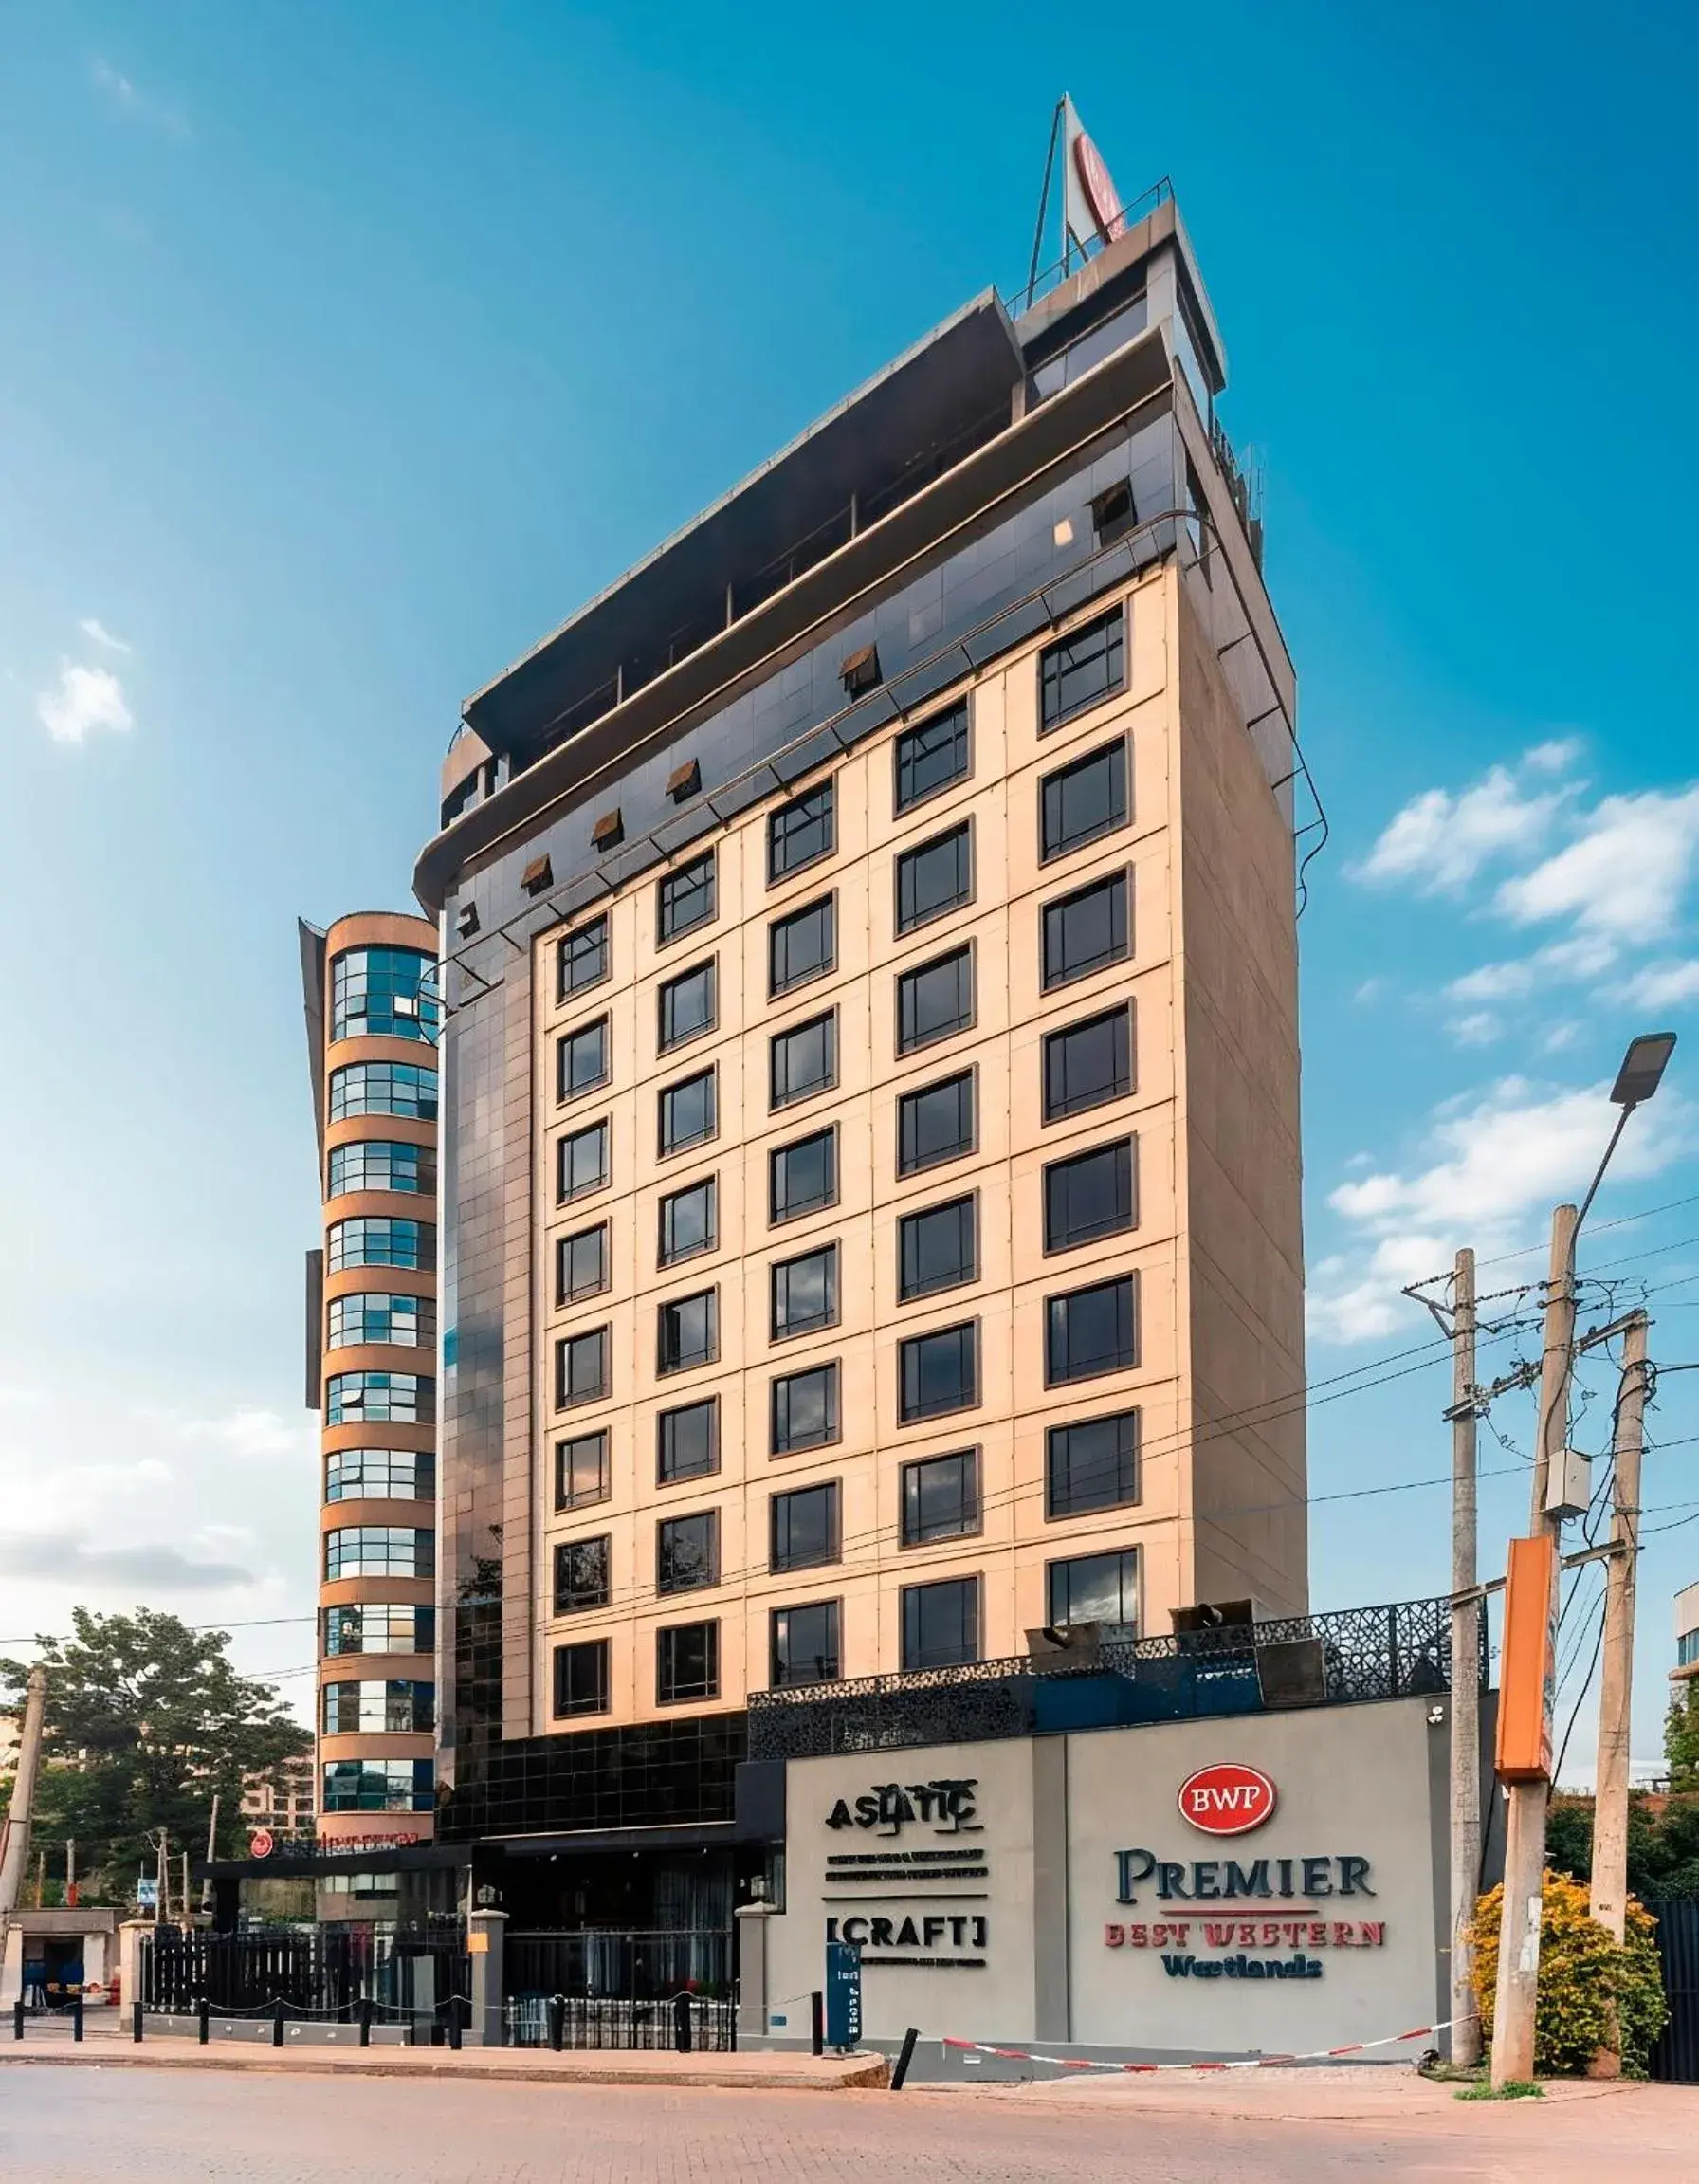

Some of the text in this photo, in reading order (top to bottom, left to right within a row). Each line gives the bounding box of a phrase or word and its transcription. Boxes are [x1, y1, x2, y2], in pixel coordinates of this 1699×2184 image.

[1190, 1785, 1261, 1812] BWP
[1113, 1848, 1378, 1905] PREMIER
[1104, 1921, 1386, 1949] BEST WESTERN
[1161, 1954, 1323, 1979] Westlands
